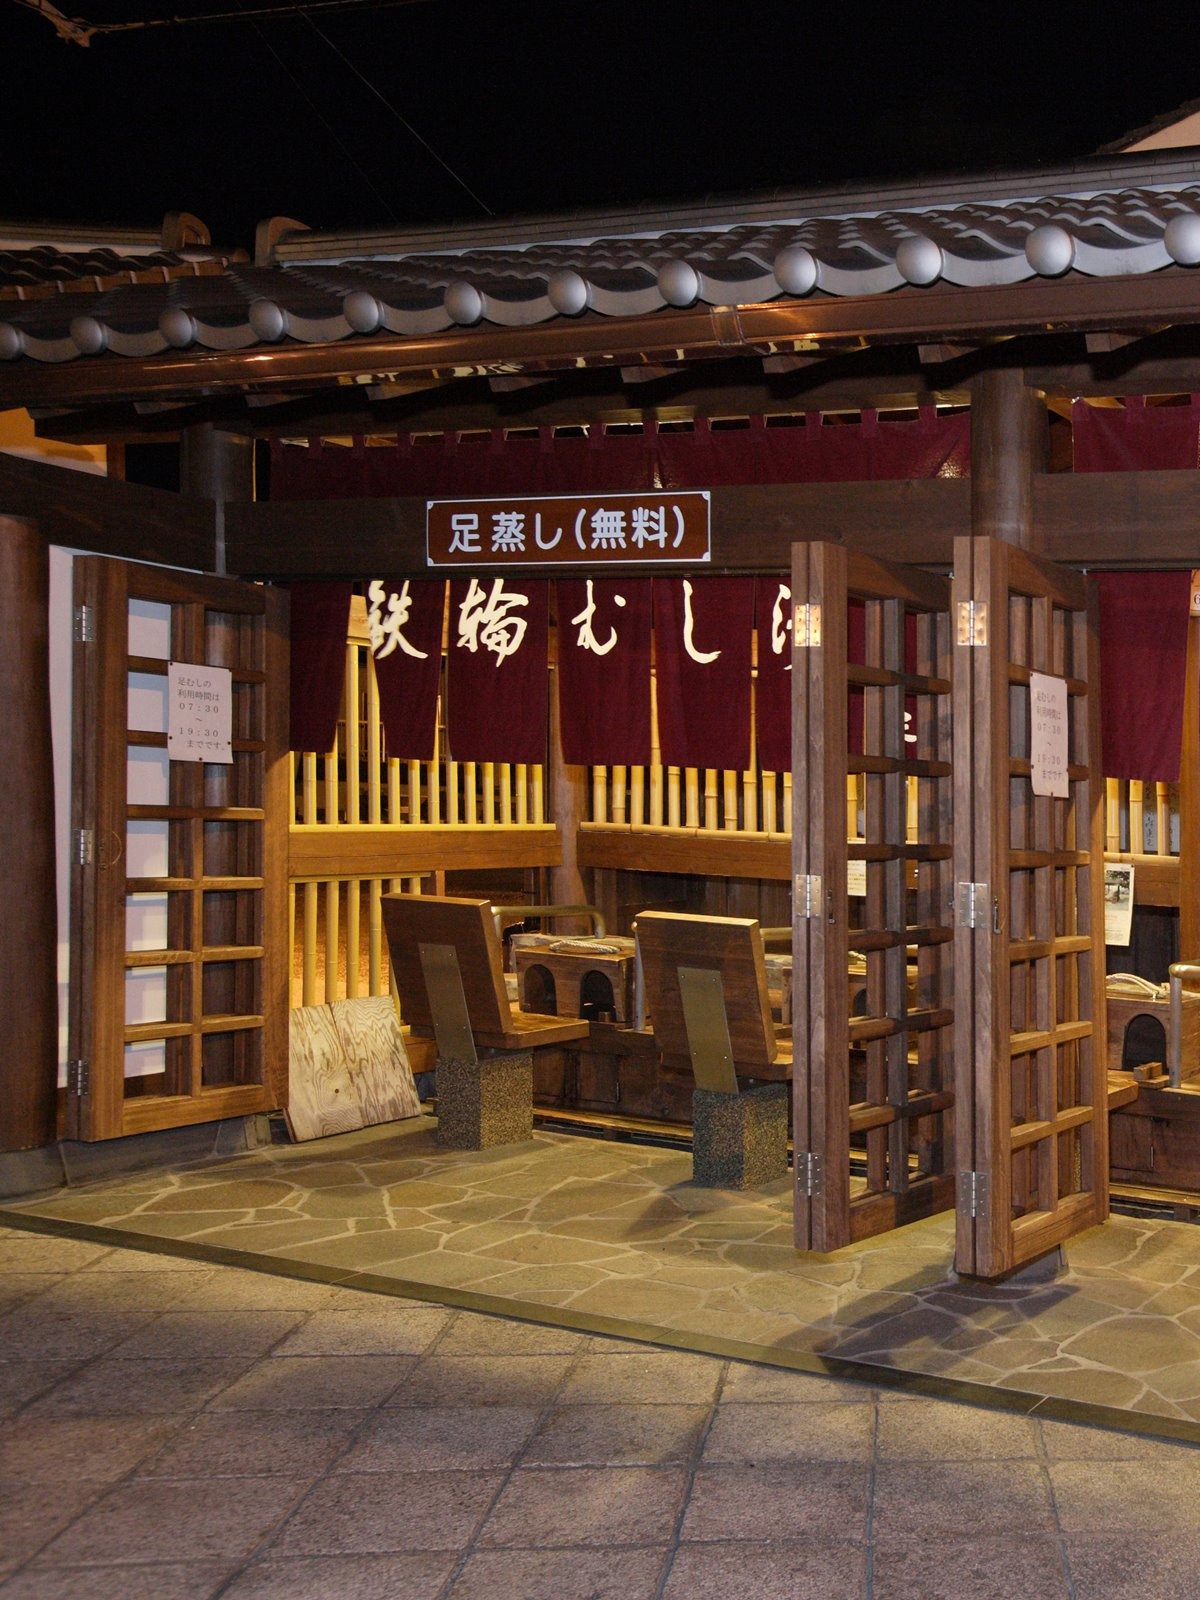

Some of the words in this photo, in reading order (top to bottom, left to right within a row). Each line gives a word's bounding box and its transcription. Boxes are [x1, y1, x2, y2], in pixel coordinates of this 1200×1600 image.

[448, 505, 685, 553] 足蒸し(無料)
[177, 676, 212, 688] 足むしの
[177, 689, 220, 702] 利用時間は
